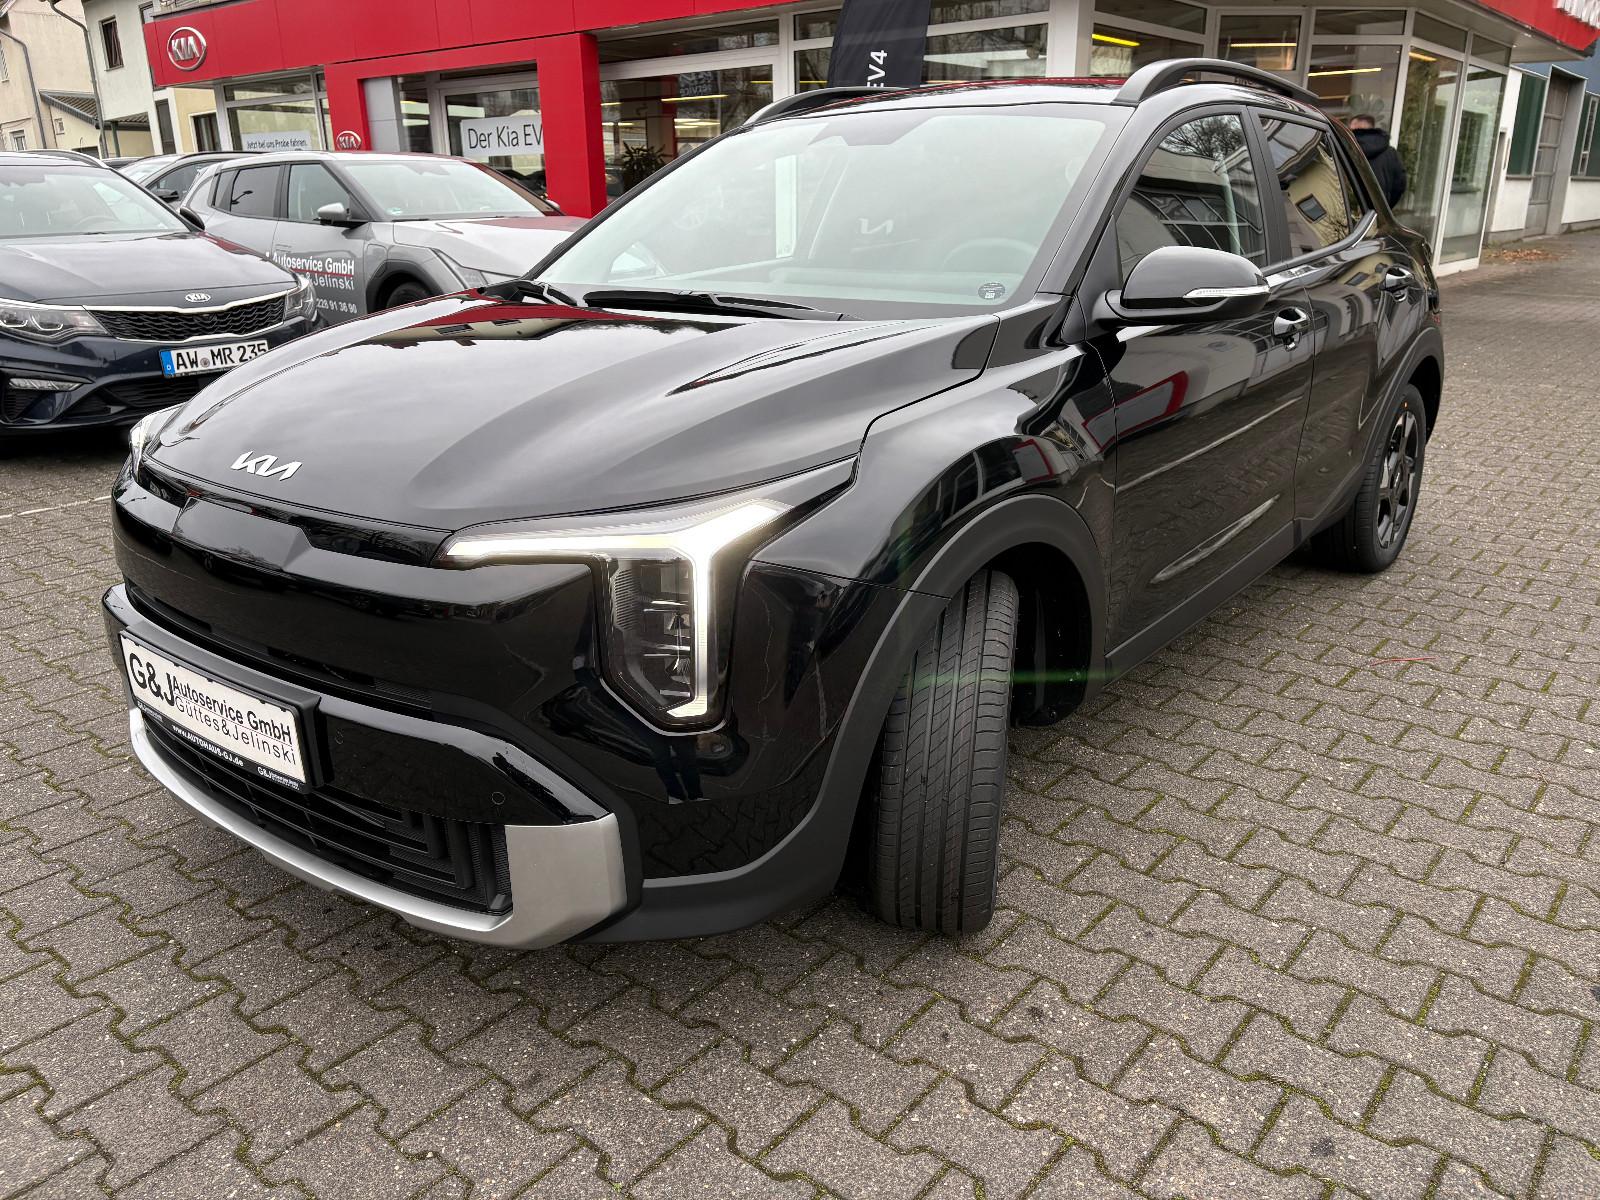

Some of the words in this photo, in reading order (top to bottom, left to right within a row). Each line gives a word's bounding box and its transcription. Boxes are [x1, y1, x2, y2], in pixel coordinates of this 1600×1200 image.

[172, 36, 200, 60] KIA
[339, 135, 358, 150] KIA
[468, 128, 493, 149] Der
[496, 125, 519, 148] Kia
[325, 258, 354, 275] GmbH
[176, 351, 199, 370] AW
[210, 347, 235, 366] MR
[230, 450, 302, 481] KIA
[129, 652, 175, 706] G&J
[173, 676, 244, 724] Autoservice
[247, 710, 292, 745] GmbH
